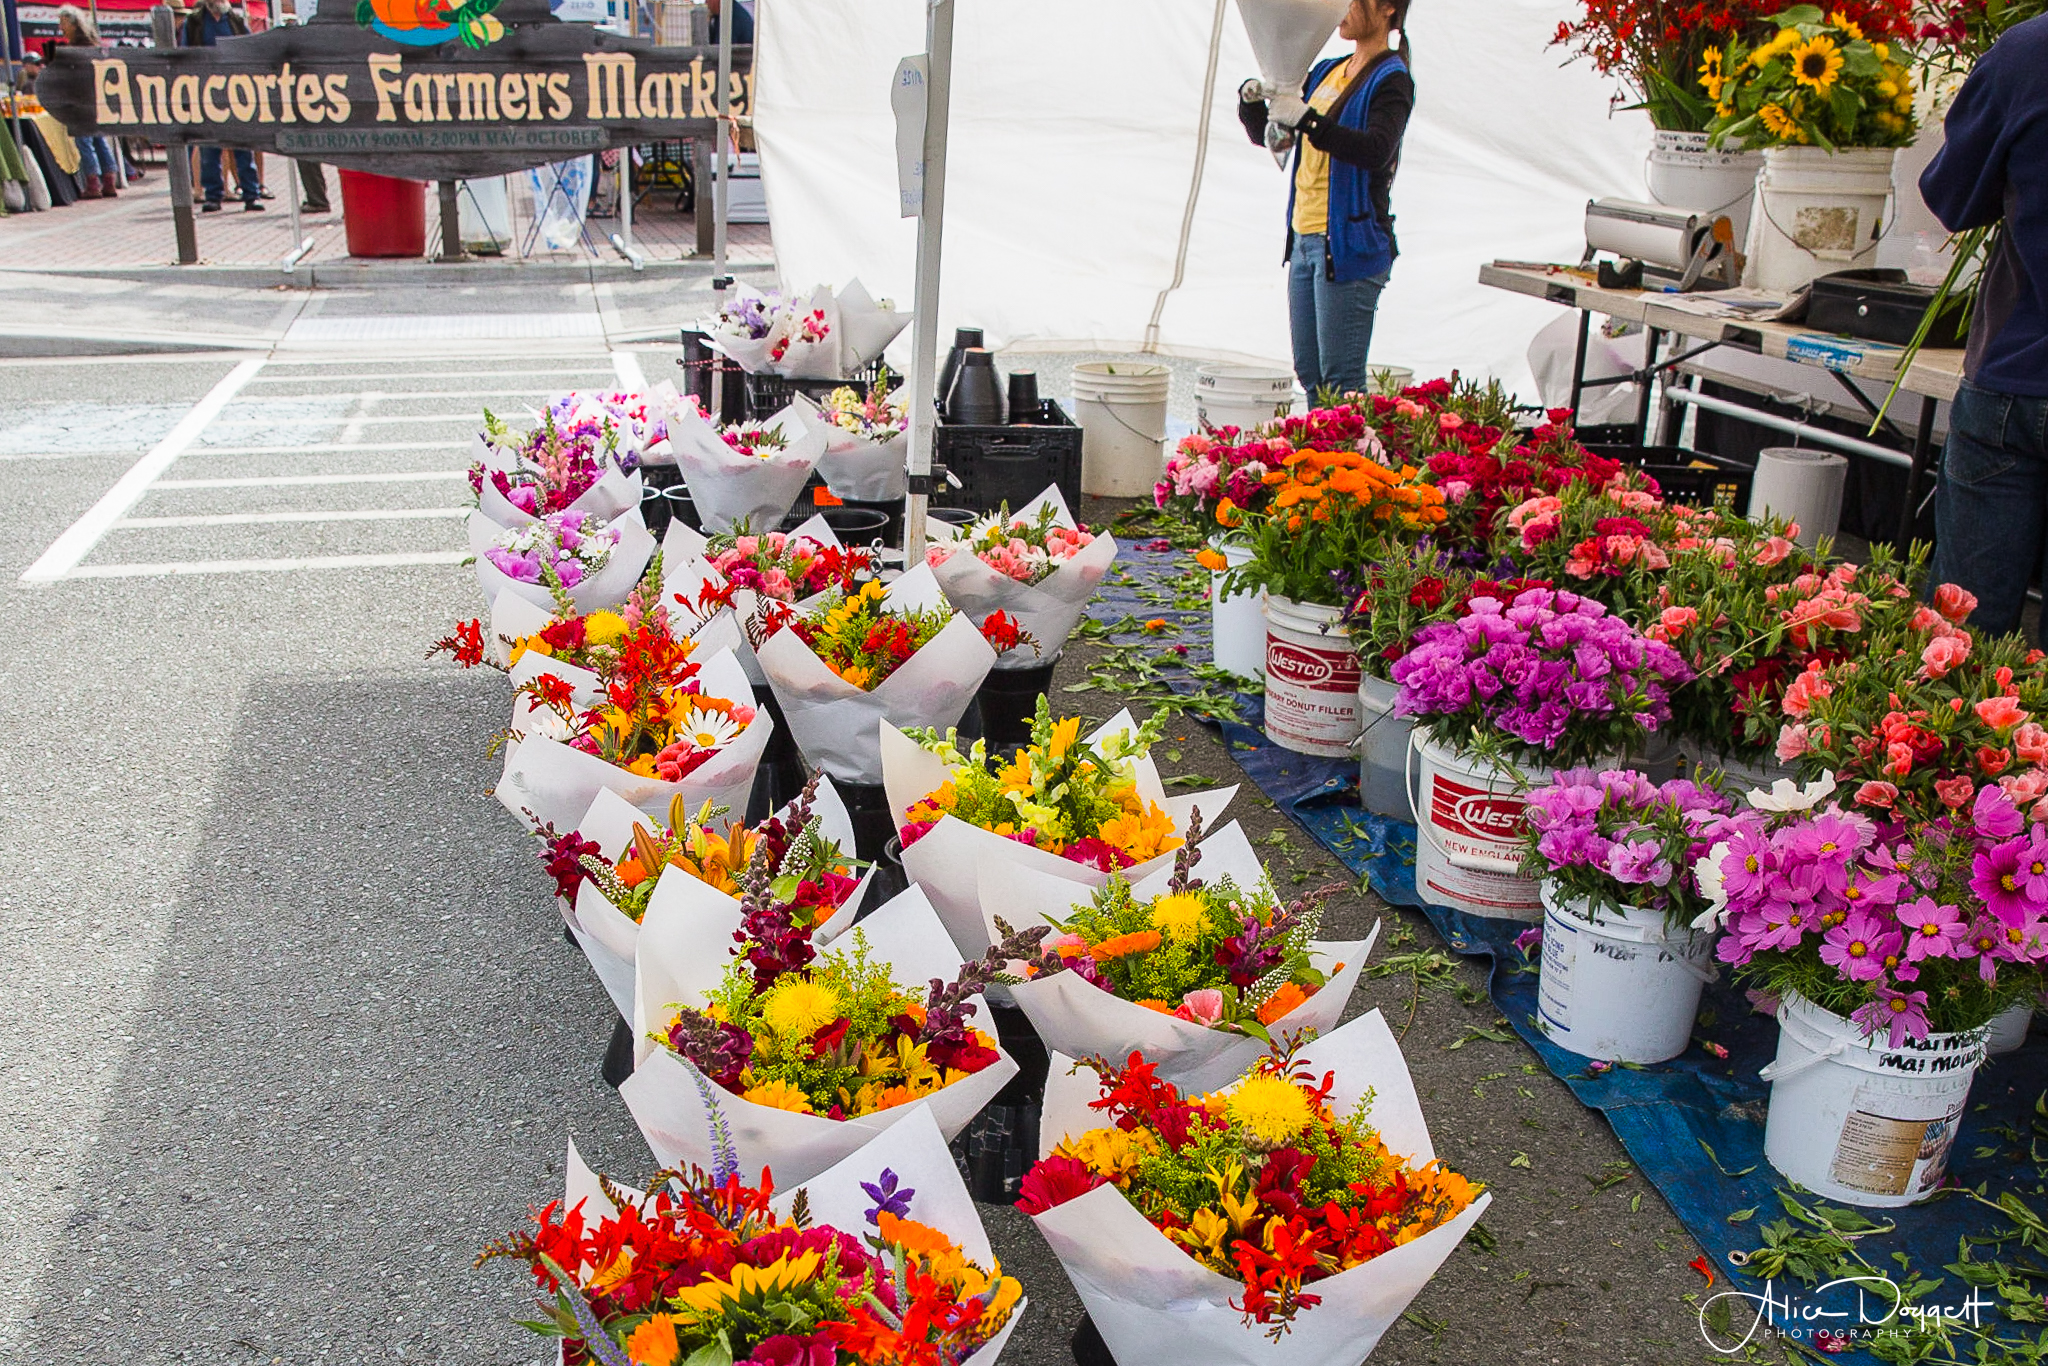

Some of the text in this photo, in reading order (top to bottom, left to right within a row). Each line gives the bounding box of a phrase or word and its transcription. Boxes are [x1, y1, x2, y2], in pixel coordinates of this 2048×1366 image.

[92, 58, 351, 125] Anacortes
[368, 52, 573, 122] Farmers
[286, 132, 367, 148] SATURDAY
[1271, 649, 1326, 678] WESTCO
[1287, 698, 1317, 712] DONUT
[1319, 705, 1354, 716] FILLER
[1445, 839, 1468, 854] NEW
